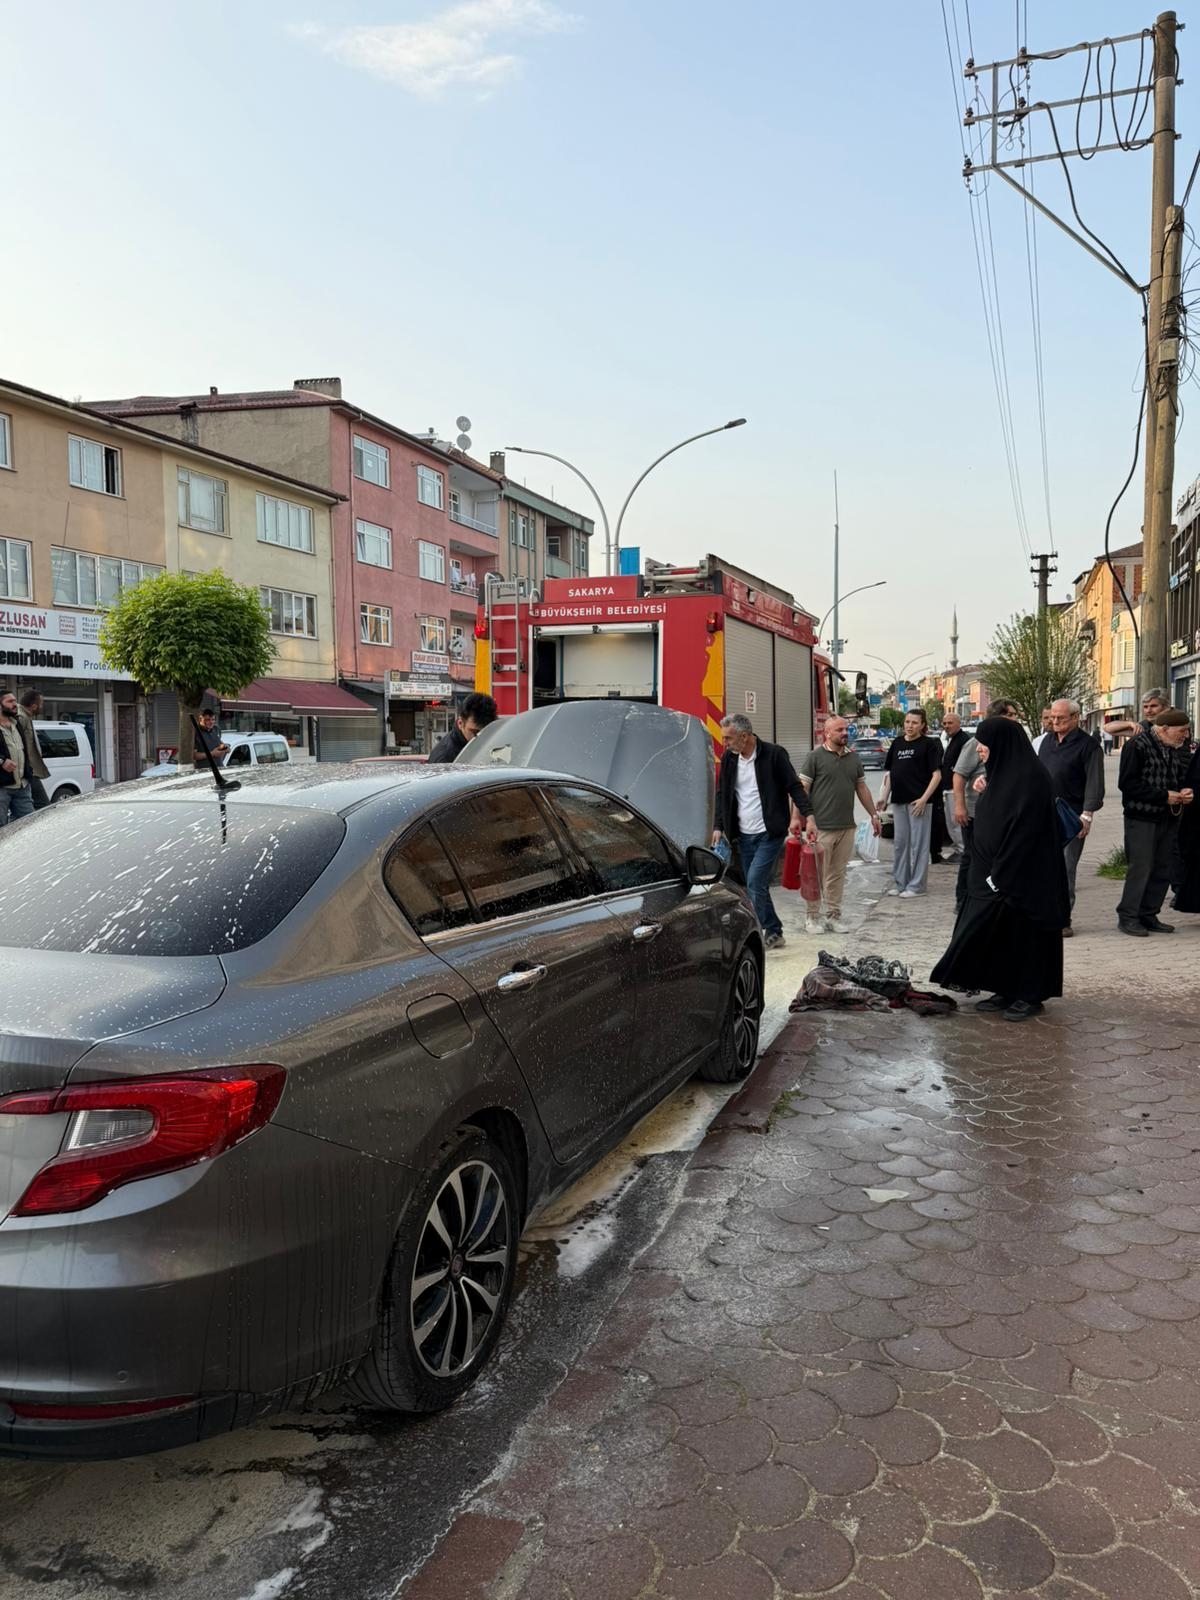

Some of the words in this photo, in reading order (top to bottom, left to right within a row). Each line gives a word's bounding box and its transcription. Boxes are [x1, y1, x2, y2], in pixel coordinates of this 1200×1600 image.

[568, 586, 615, 598] SAKARYA
[541, 604, 602, 618] BÜYÜKŞEHİR
[607, 602, 667, 615] BELEDİYESİ
